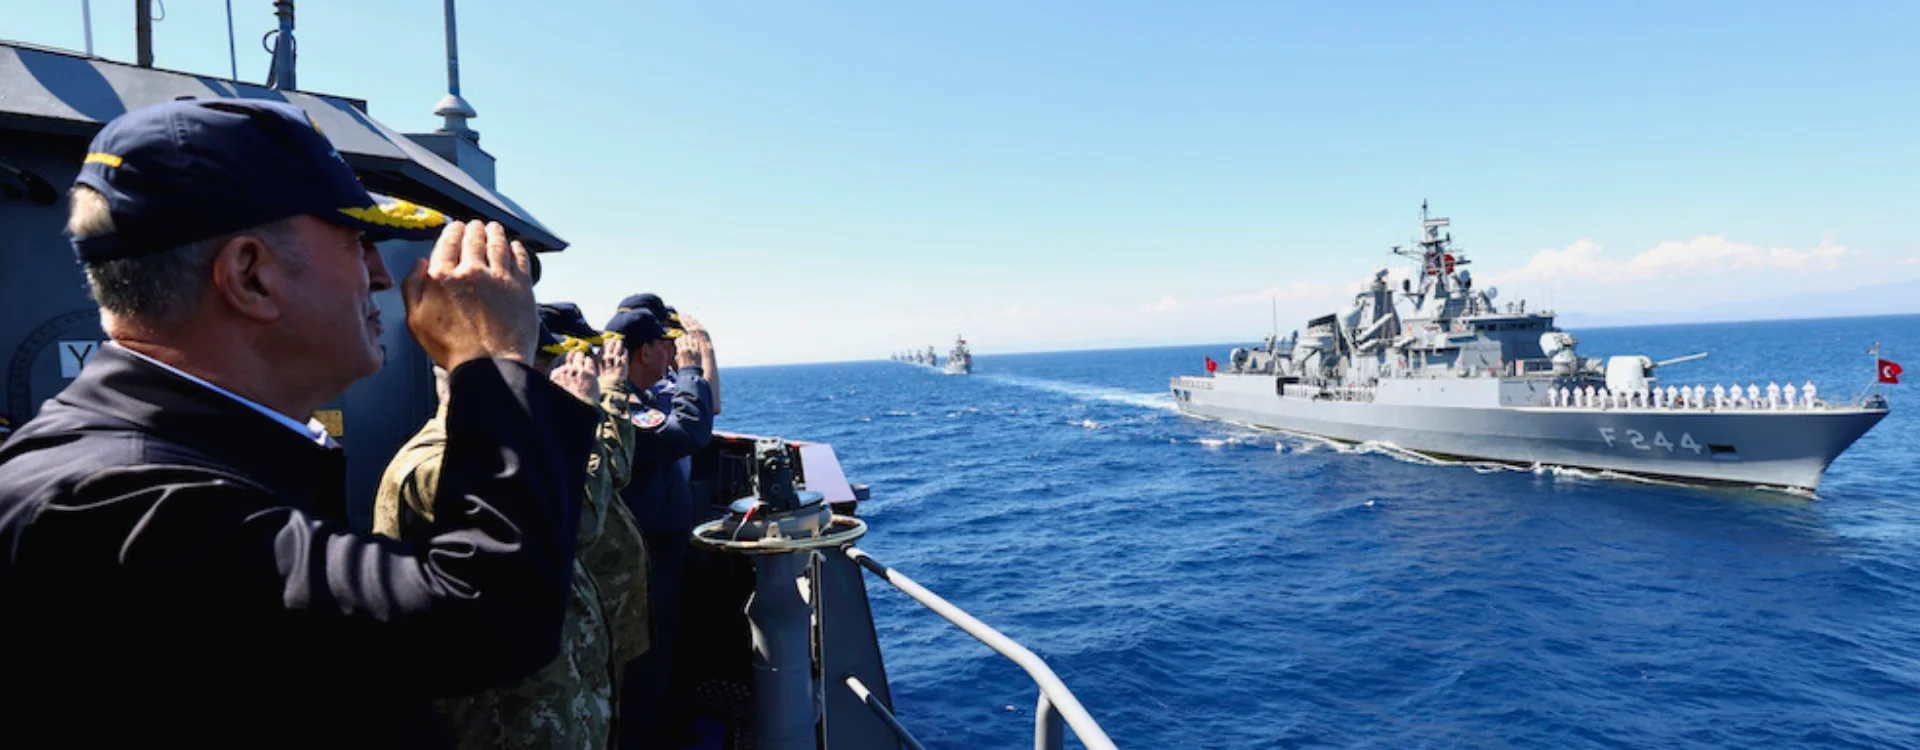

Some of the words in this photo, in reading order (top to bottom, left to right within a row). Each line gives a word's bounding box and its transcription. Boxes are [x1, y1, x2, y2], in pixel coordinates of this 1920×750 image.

[66, 343, 93, 371] Y
[1599, 427, 1616, 447] F
[1625, 429, 1702, 454] 244
